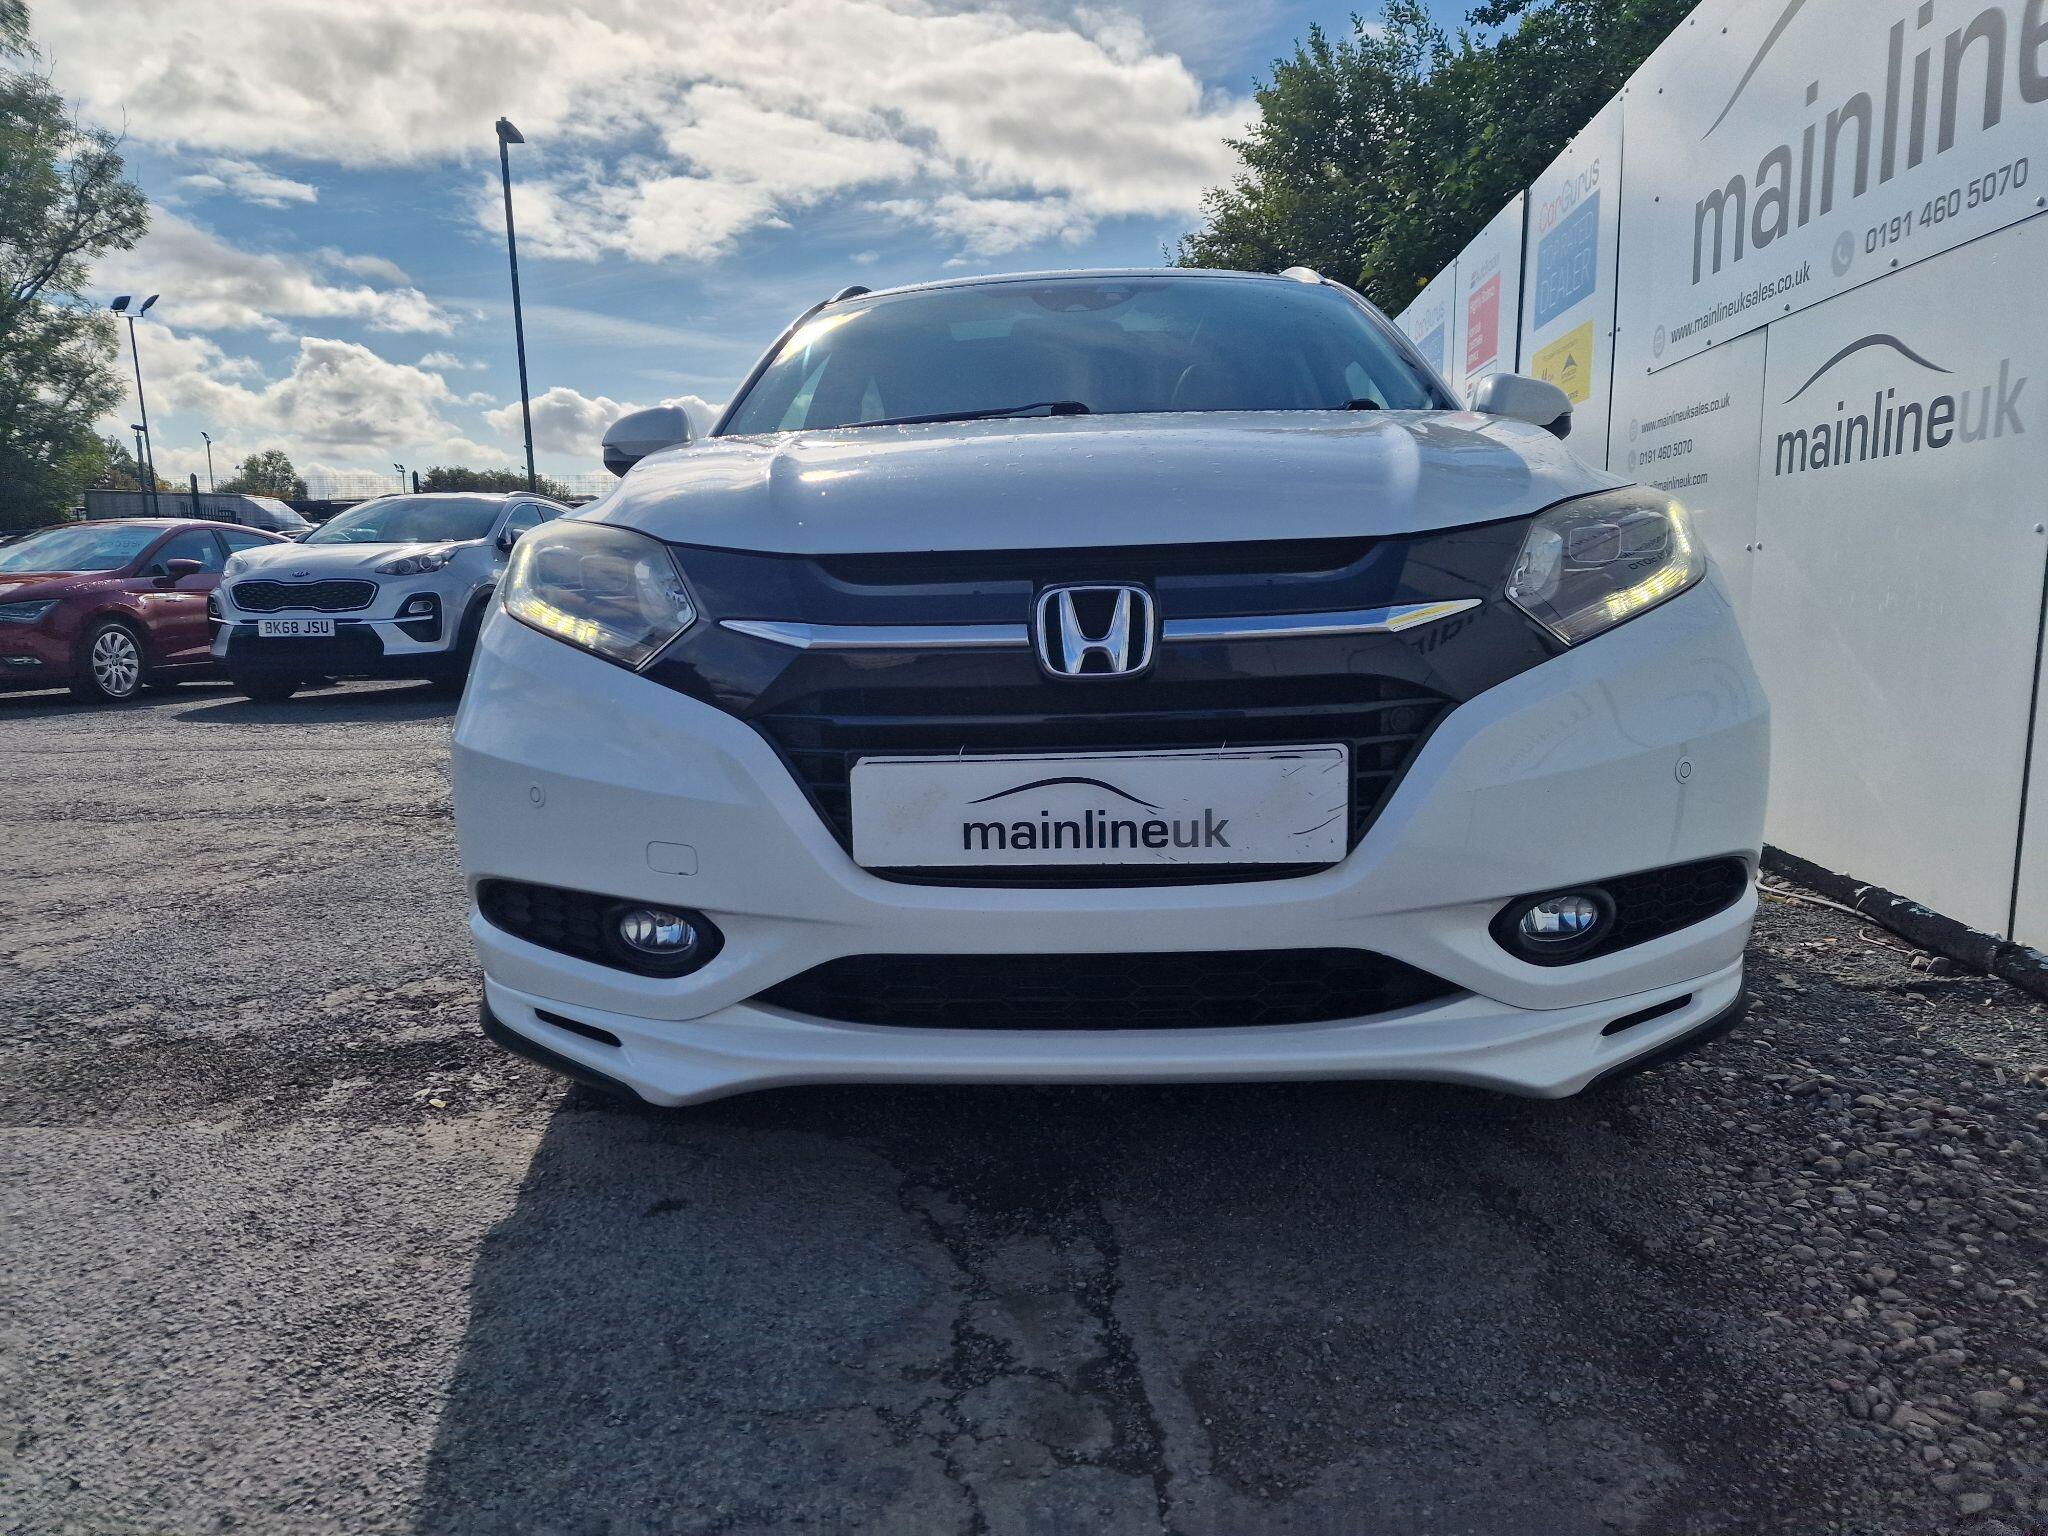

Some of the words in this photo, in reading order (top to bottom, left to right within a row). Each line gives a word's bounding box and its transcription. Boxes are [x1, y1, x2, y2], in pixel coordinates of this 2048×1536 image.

[1538, 158, 1599, 234] CarGurus
[1865, 210, 1912, 254] 0191
[1919, 188, 1961, 228] 460
[1967, 157, 2029, 209] 5070
[1540, 247, 1591, 314] DEALER
[1671, 260, 1811, 343] www.mainlineuksales.co.uk
[1641, 392, 1731, 433] www.mainlineuksales.co.uk
[1775, 358, 2028, 476] mainlineuk
[1639, 449, 1656, 466] 0191
[1657, 445, 1672, 460] 460
[1673, 439, 1693, 457] 5070
[265, 621, 299, 634] BK68
[303, 621, 329, 634] JSU
[963, 809, 1231, 850] mainlineuk
